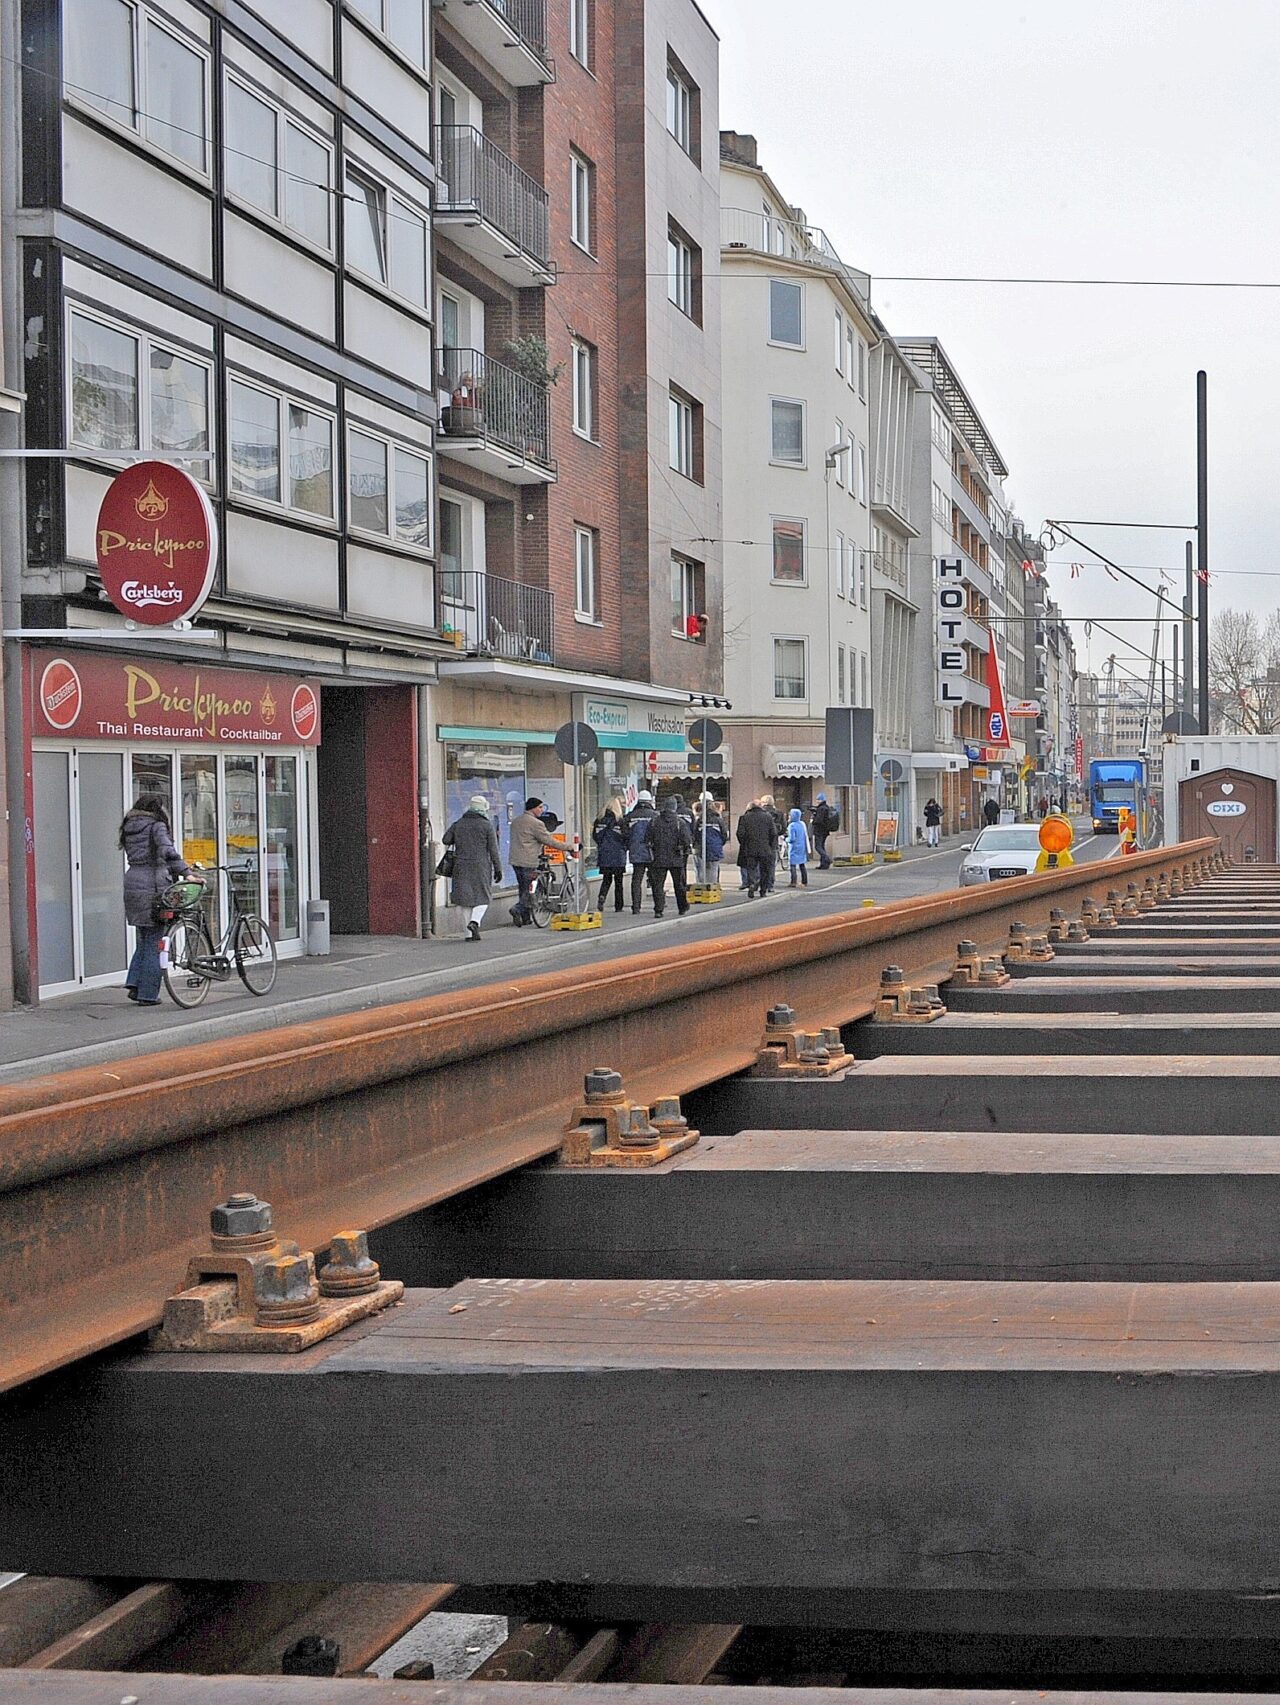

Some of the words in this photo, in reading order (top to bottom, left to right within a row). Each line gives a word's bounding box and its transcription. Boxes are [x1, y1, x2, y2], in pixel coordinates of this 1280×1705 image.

[98, 528, 204, 568] Prickynoo
[121, 581, 183, 605] Carlsberg
[940, 559, 963, 701] HOTEL
[123, 664, 253, 737] Prickynoo
[96, 721, 128, 735] Thai
[133, 723, 203, 737] Restaurant
[220, 727, 282, 741] Cocktailbar
[647, 712, 685, 733] Waschsalon
[991, 714, 1002, 737] ARLT
[778, 764, 801, 772] Beauty
[1212, 804, 1241, 812] DIXI
